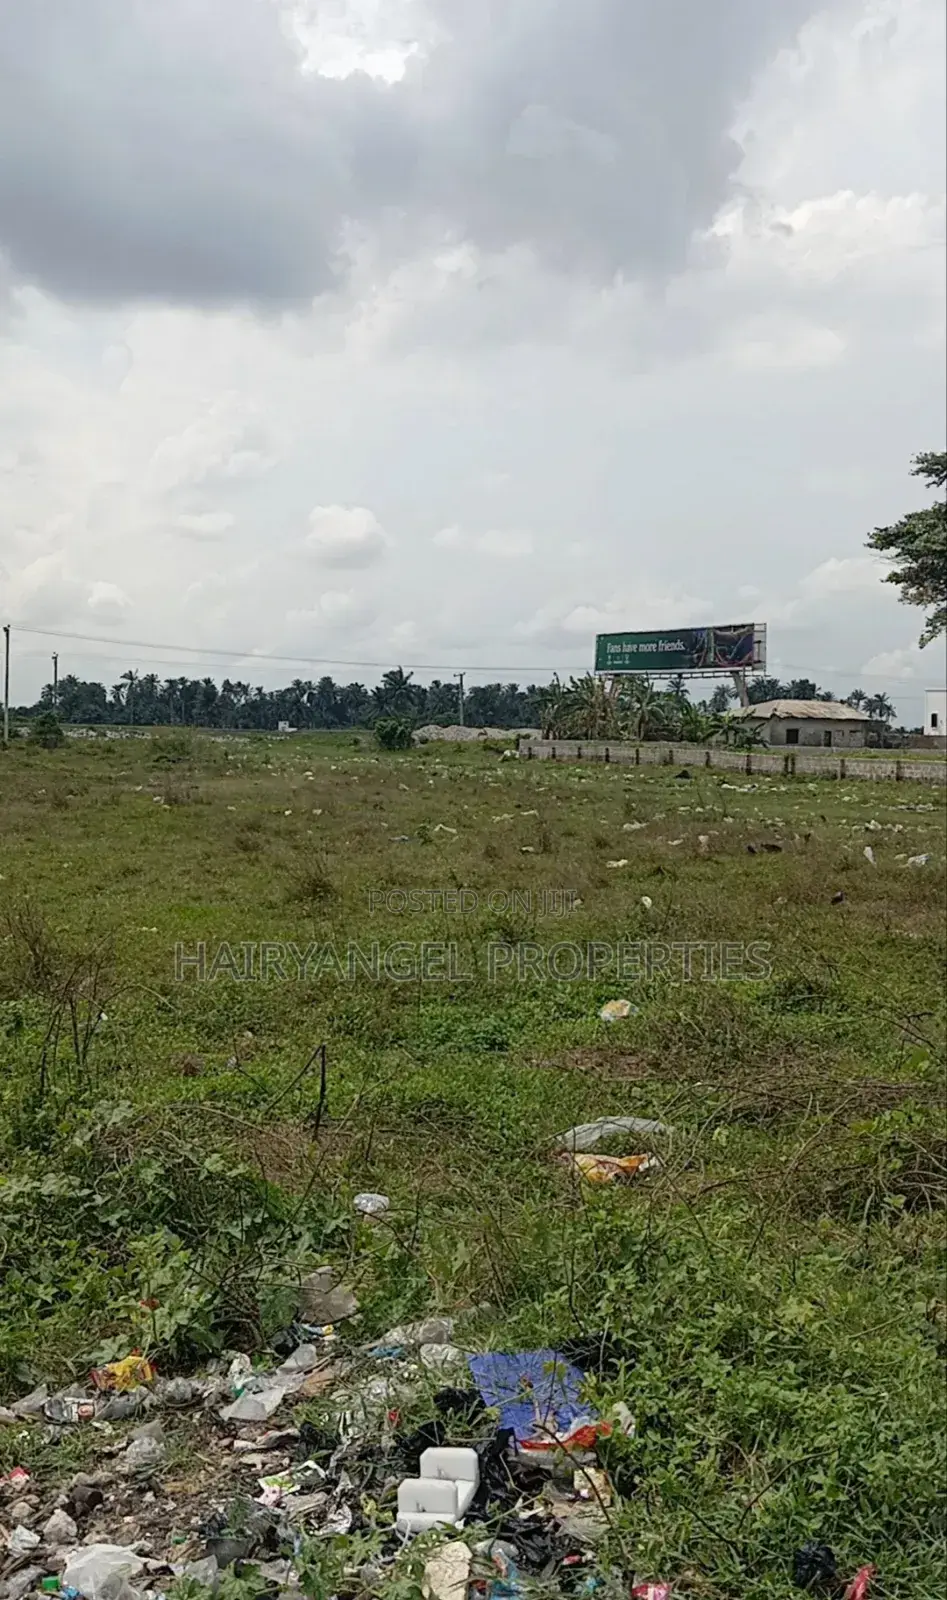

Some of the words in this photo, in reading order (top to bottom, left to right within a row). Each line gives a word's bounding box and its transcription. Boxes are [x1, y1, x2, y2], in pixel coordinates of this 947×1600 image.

[606, 643, 621, 653] Fans
[622, 641, 637, 653] have
[639, 642, 656, 652] more
[658, 639, 686, 652] friends.
